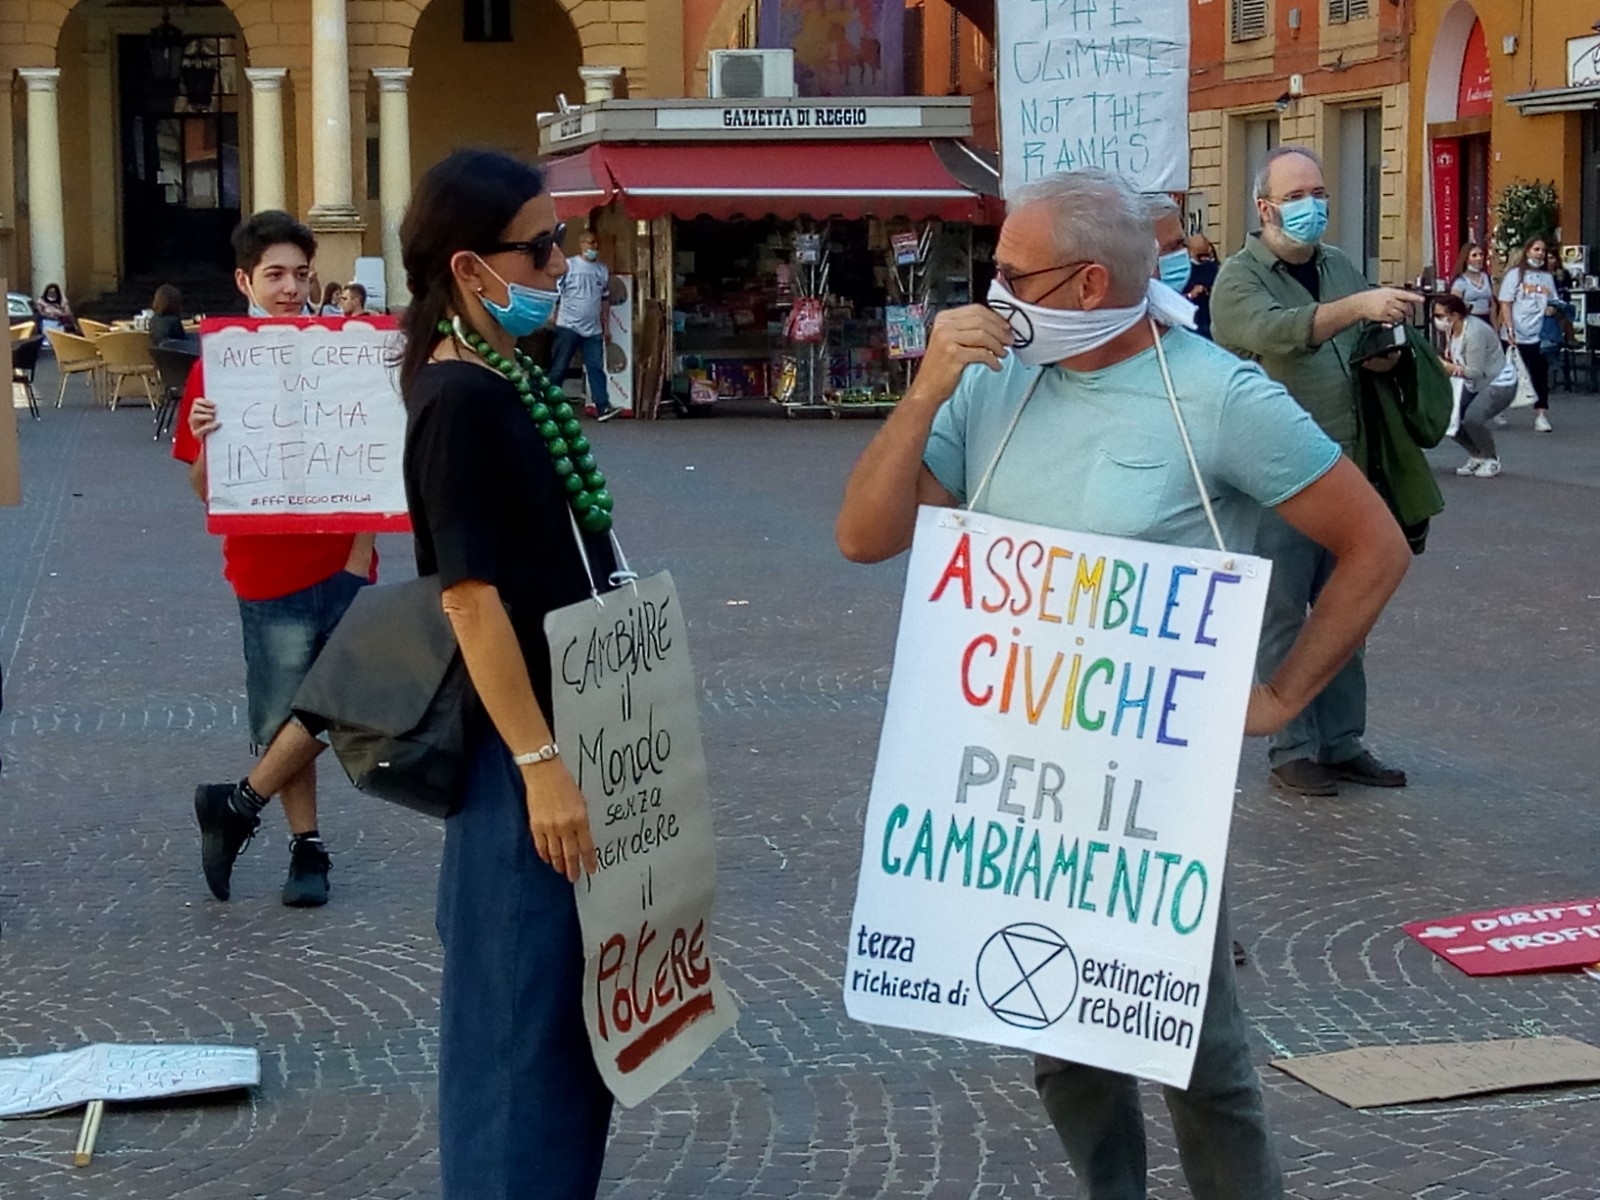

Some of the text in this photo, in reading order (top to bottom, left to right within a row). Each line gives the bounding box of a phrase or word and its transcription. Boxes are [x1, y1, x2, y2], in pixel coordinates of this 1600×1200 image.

[1030, 0, 1143, 31] THE
[722, 107, 868, 127] GAZZETTA DI REGGIO
[1082, 91, 1164, 135] THE
[222, 345, 396, 367] AVETE CREAT
[283, 374, 320, 392] UN
[227, 441, 388, 481] INFAME
[929, 532, 1242, 647] ASSEMBLEE
[578, 702, 671, 796] Mondo
[955, 745, 1066, 823] PER
[857, 925, 915, 963] terza
[851, 968, 970, 1007] richiesta di
[1081, 956, 1200, 1008] extinction
[1078, 993, 1195, 1050] rebellion
